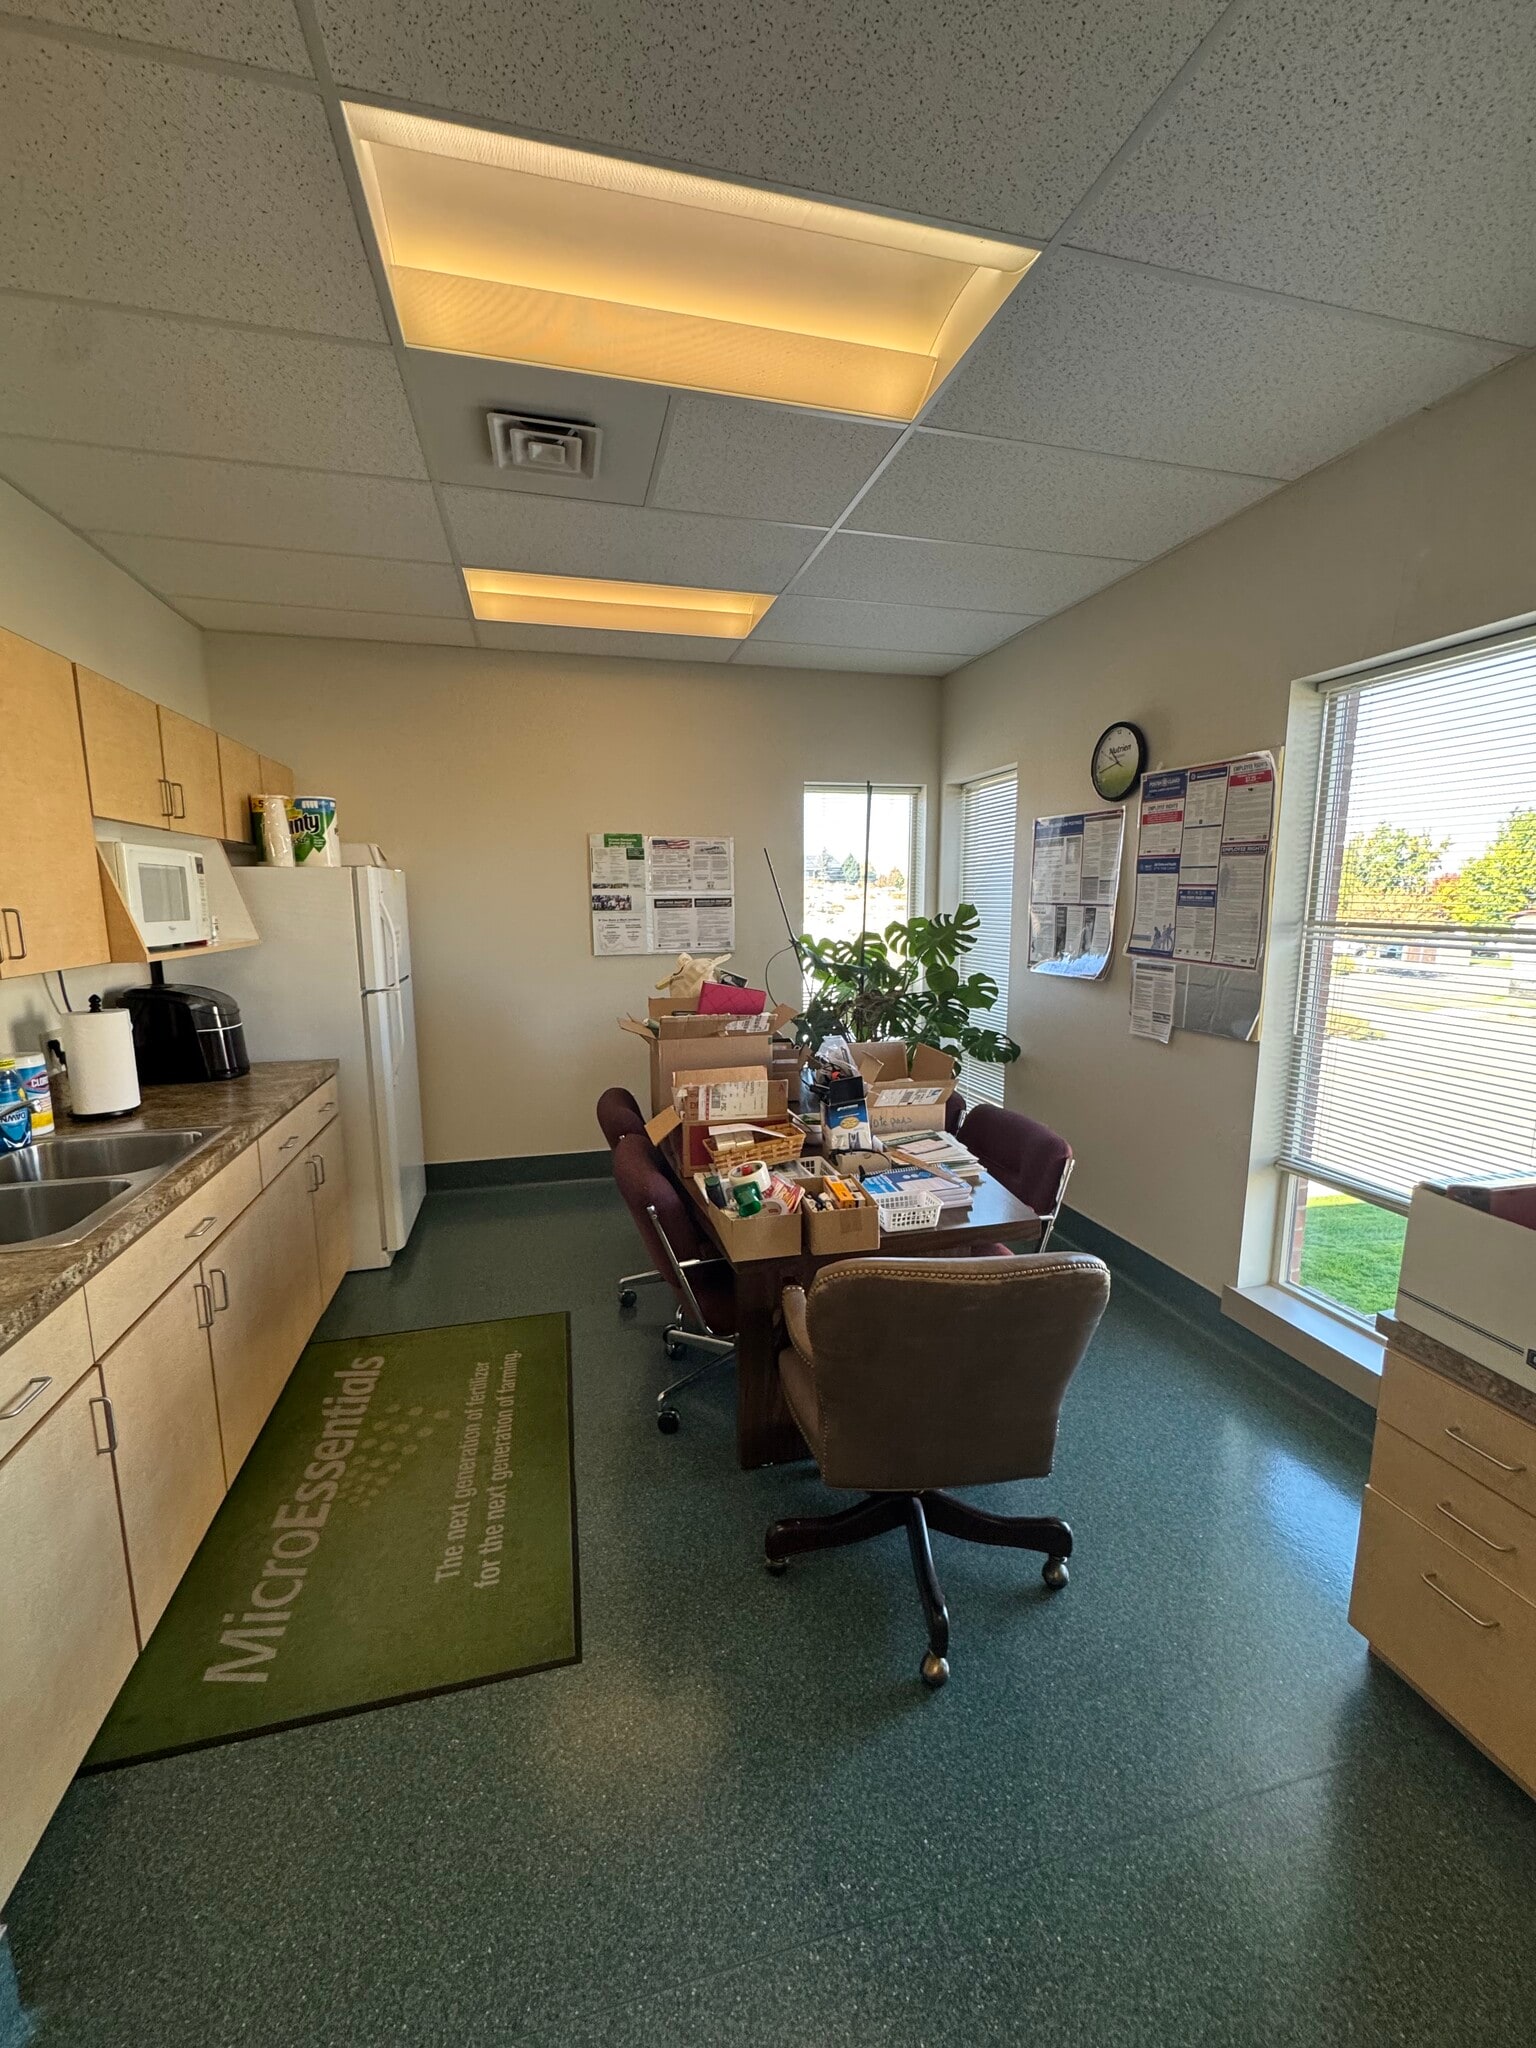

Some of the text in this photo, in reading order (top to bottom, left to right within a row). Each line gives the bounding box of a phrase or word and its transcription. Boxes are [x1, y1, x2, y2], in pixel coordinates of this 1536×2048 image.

[1109, 744, 1132, 754] Nutrien
[289, 814, 320, 834] nty
[1, 1112, 26, 1124] DAWN
[203, 1355, 386, 1683] MicroEssentials
[434, 1361, 490, 1584] The next generation of fertilizer
[473, 1349, 522, 1589] for the next generation of farming.
